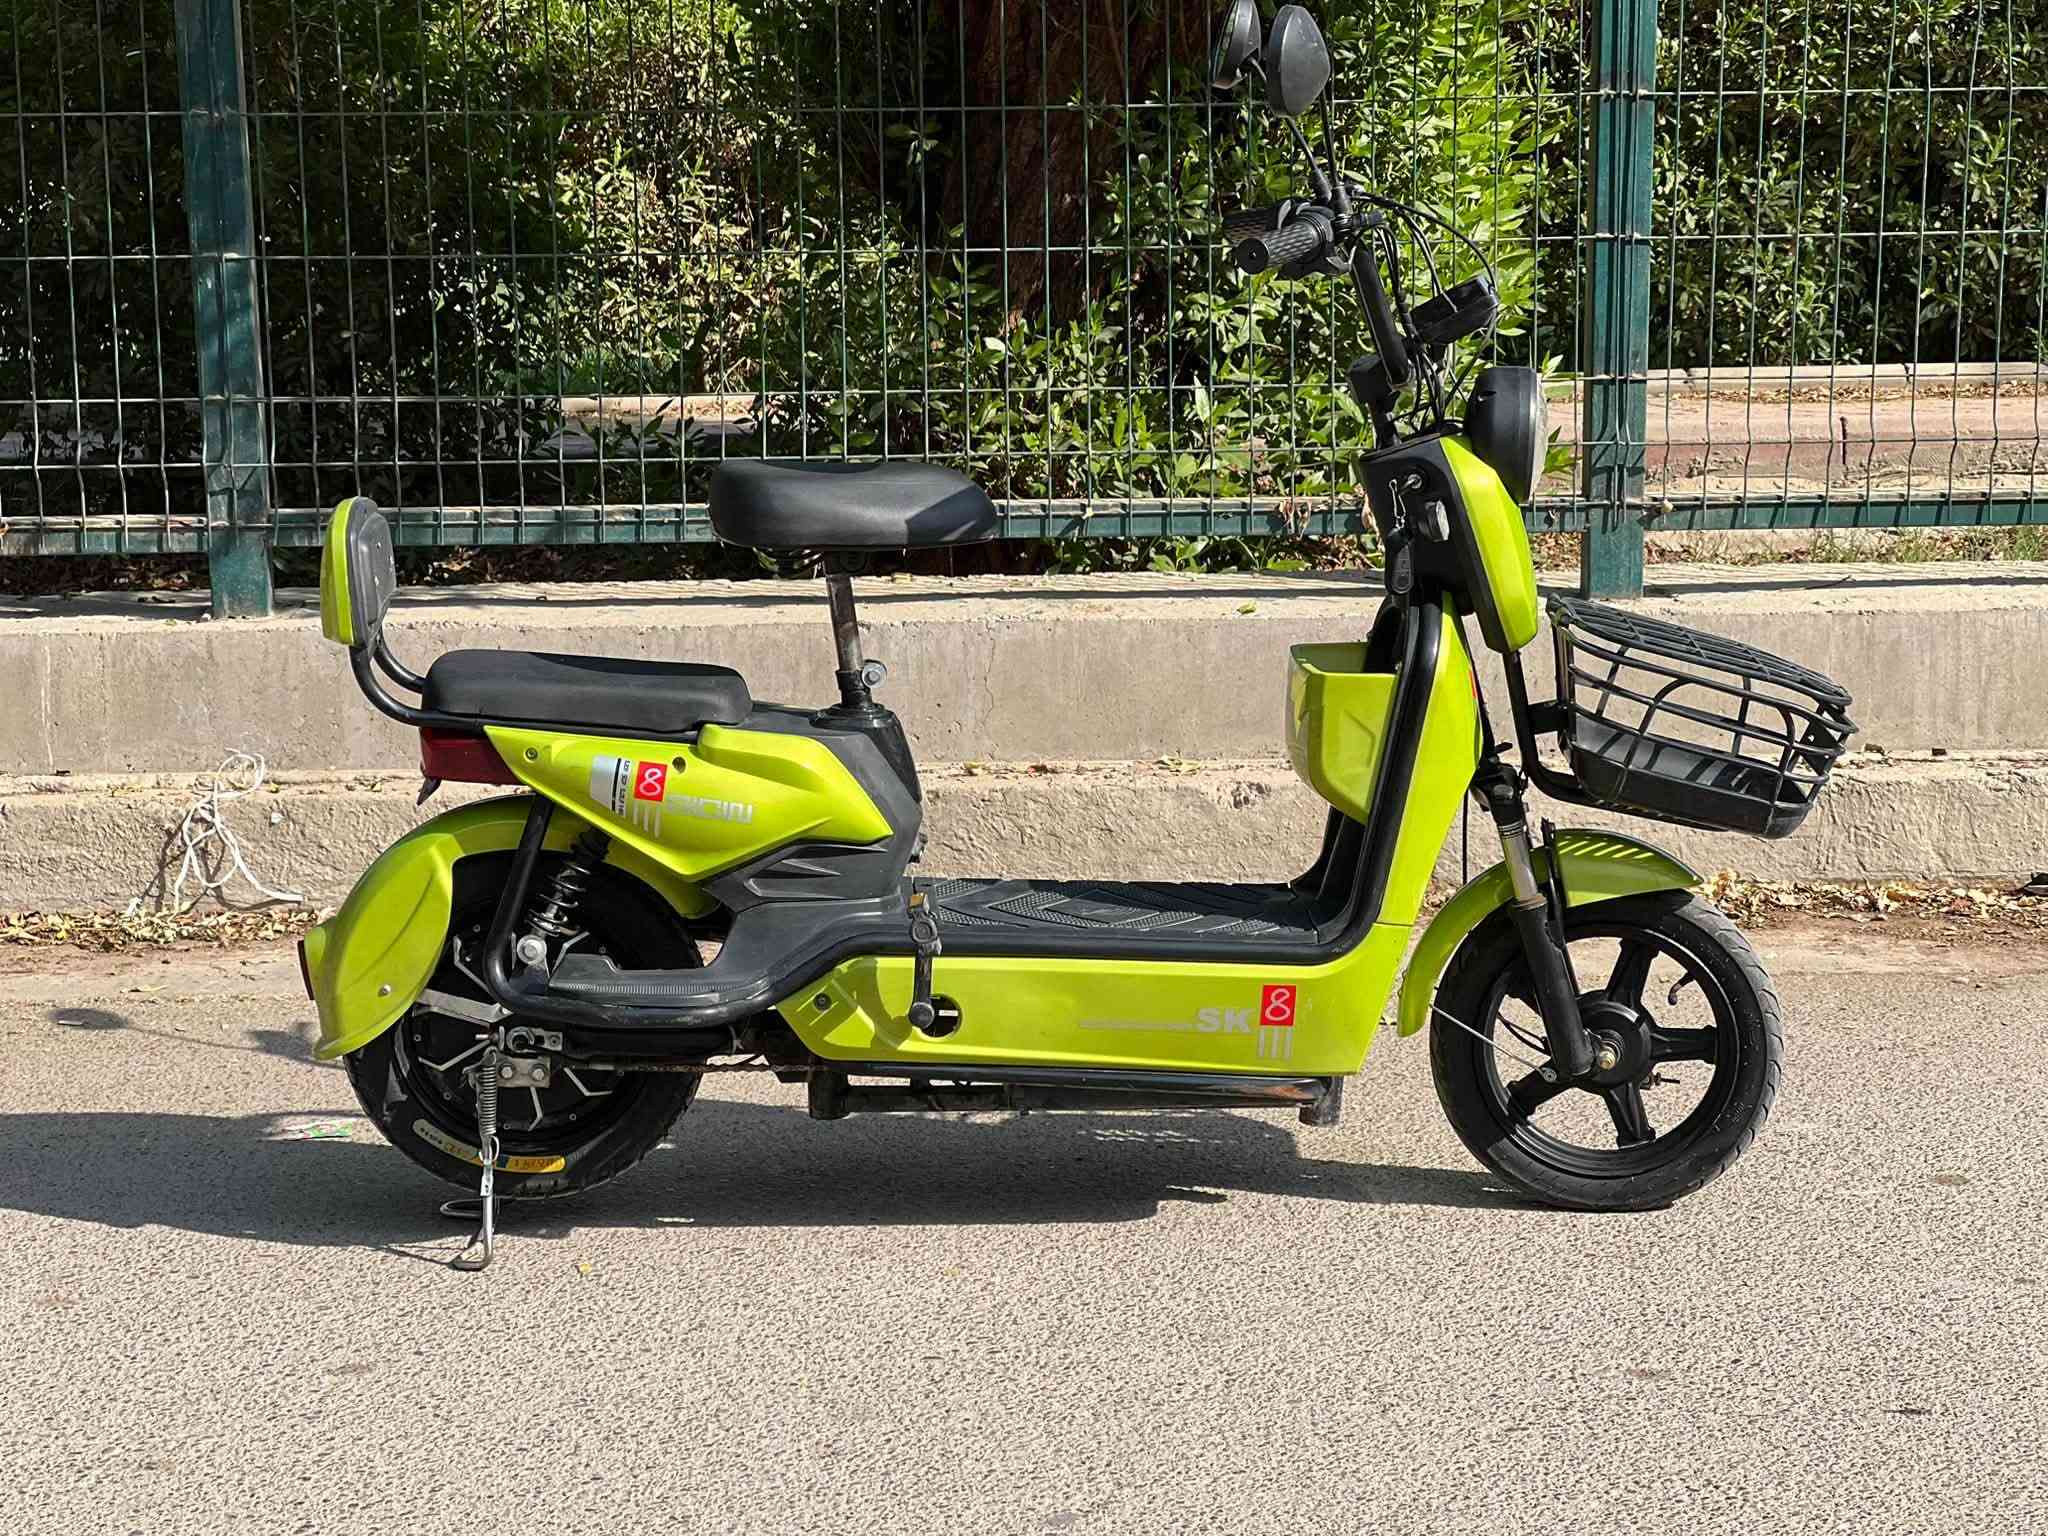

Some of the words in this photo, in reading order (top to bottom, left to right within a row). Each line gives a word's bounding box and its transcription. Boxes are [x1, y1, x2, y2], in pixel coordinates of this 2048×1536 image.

[639, 767, 663, 796] 8
[1197, 1007, 1253, 1033] SK
[1264, 988, 1291, 1021] 8
